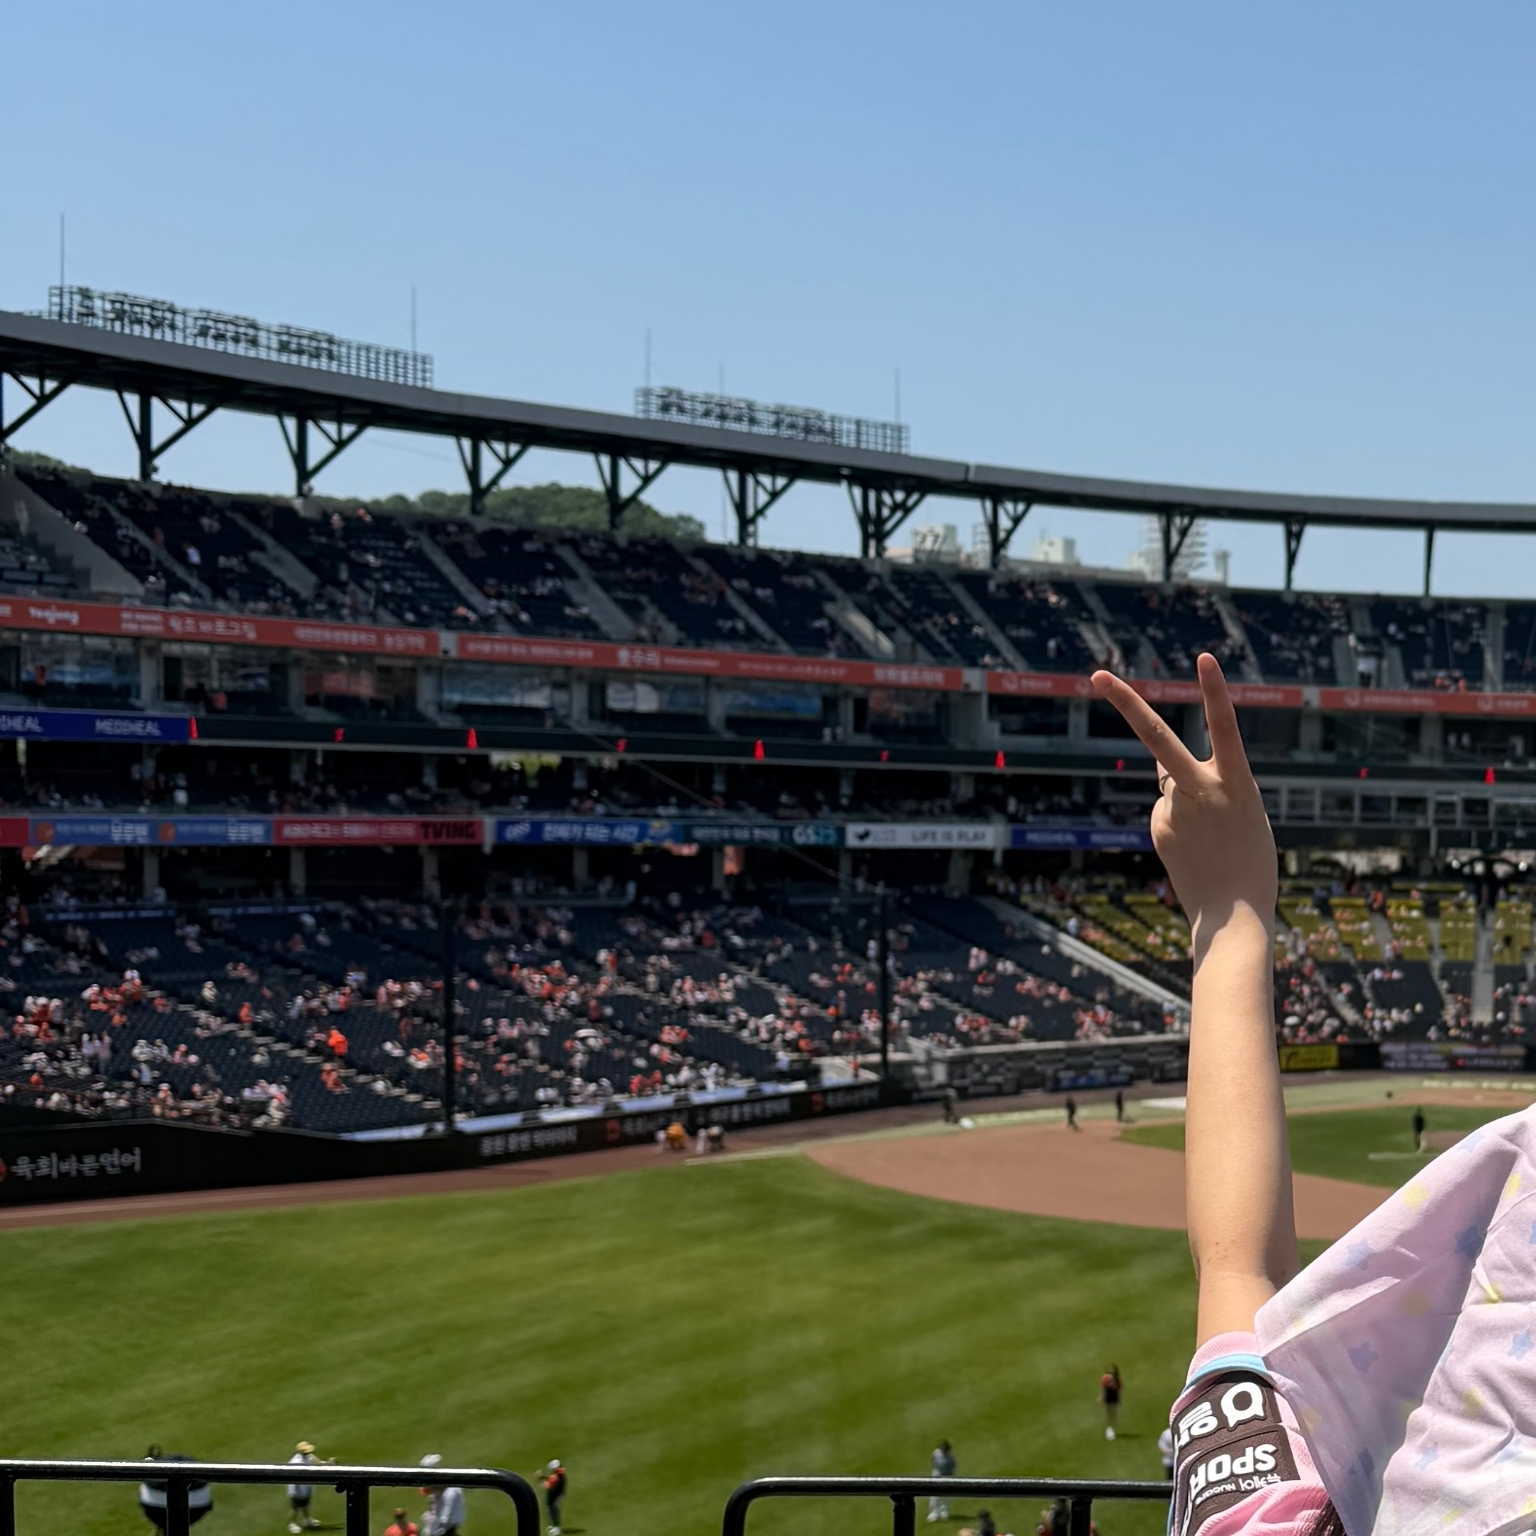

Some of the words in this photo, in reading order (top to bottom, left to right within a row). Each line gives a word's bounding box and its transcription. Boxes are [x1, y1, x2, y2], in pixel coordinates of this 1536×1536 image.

[94, 717, 163, 738] MEDIHEAL
[420, 821, 476, 840] TVING
[792, 825, 838, 845] GS25
[9, 1146, 142, 1181] 육회바른연어
[1190, 1443, 1278, 1501] SPOR
